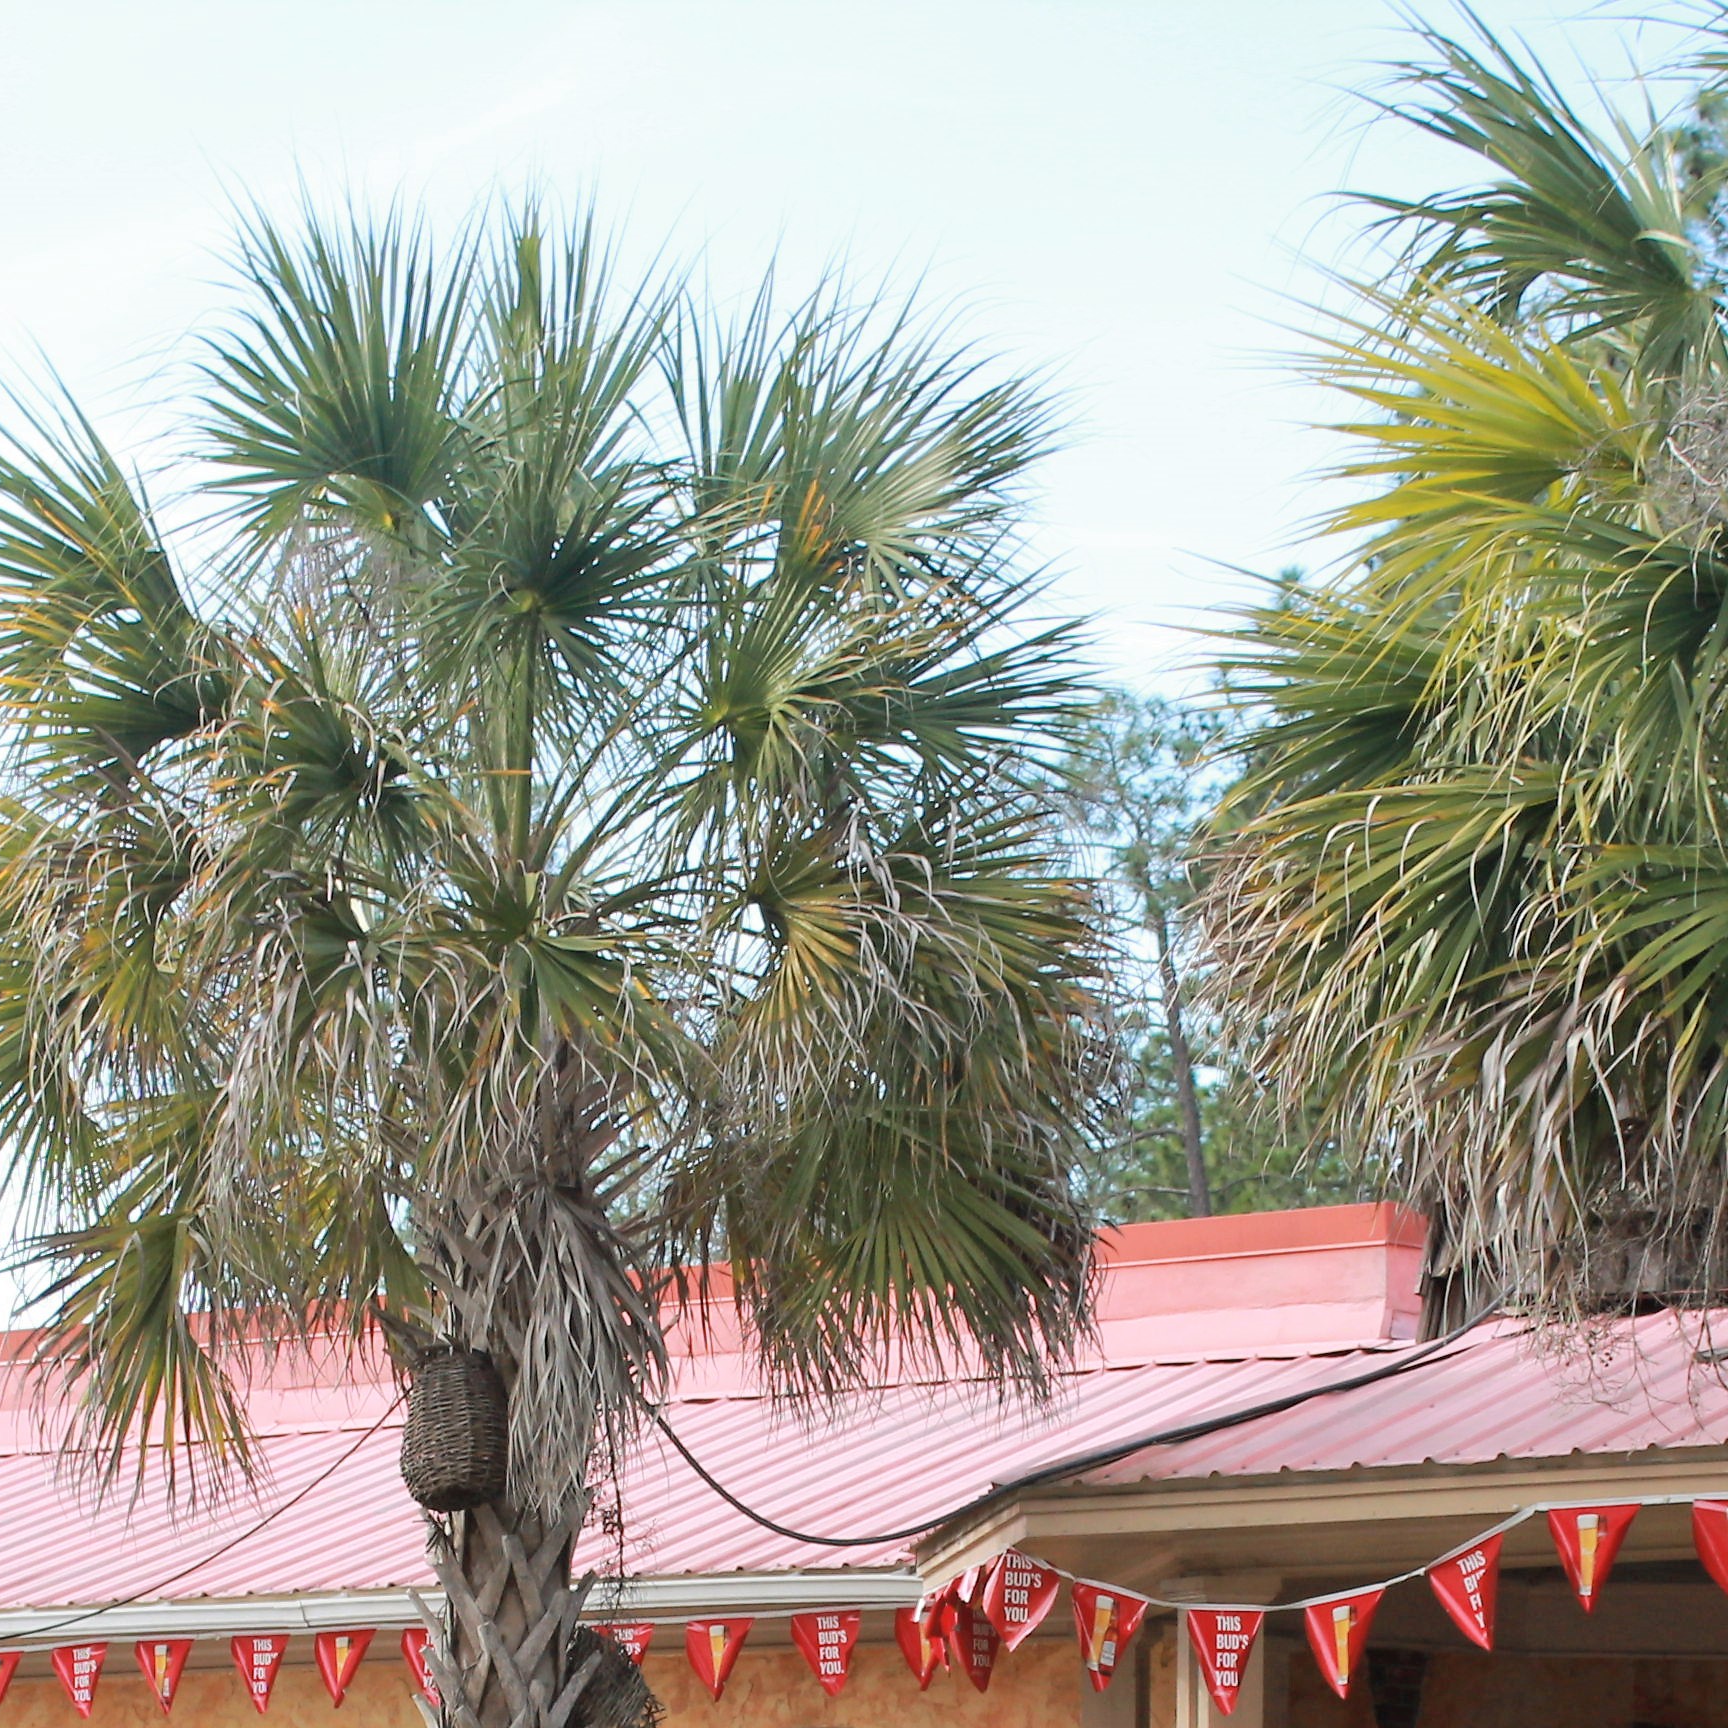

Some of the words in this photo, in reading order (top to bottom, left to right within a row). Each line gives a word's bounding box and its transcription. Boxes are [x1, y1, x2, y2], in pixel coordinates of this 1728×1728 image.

[1005, 1553, 1032, 1570] THIS
[1456, 1550, 1487, 1575] THIS
[1005, 1571, 1042, 1588] BUD'S
[1004, 1588, 1028, 1604] FOR
[817, 1615, 839, 1630] THIS
[1004, 1607, 1031, 1623] YOU.
[1215, 1615, 1241, 1631] THIS
[253, 1639, 272, 1652] THIS
[818, 1630, 847, 1646] BUD'S
[1216, 1633, 1249, 1650] BUD'S
[819, 1646, 839, 1660] FOR
[1216, 1652, 1238, 1668] FOR
[820, 1661, 844, 1676] YOU.
